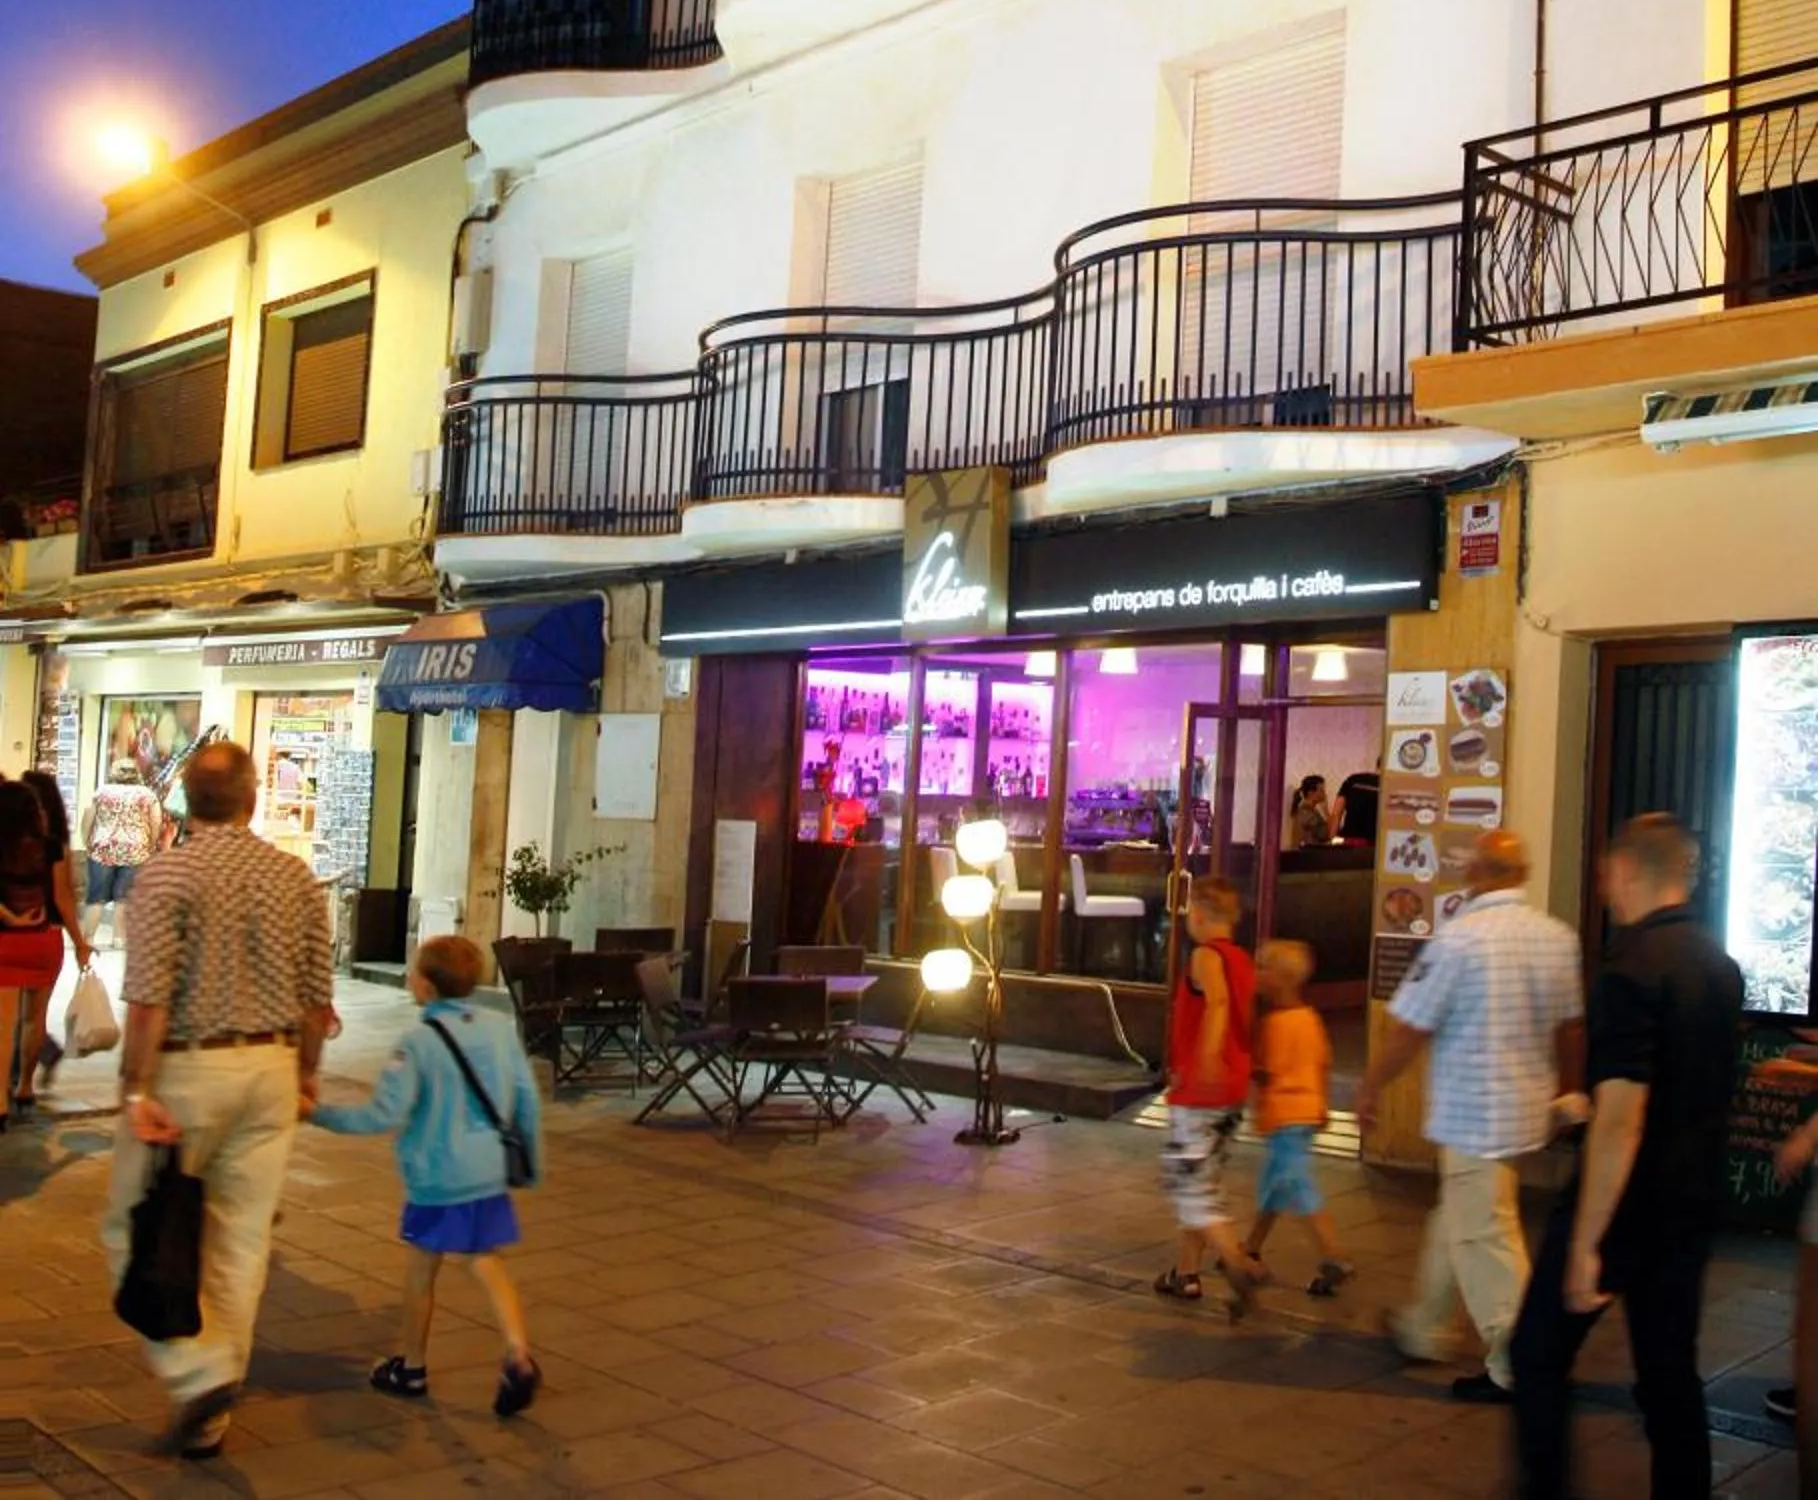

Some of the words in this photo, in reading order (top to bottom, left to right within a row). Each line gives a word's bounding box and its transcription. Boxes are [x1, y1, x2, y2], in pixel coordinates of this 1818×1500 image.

[1091, 588, 1175, 615] entrepans
[1179, 582, 1202, 606] de
[1206, 579, 1278, 607] forquilla
[1281, 573, 1288, 598] i
[228, 643, 305, 664] PERFUMERIA
[321, 639, 376, 660] REGALS
[414, 643, 478, 681] IRIS
